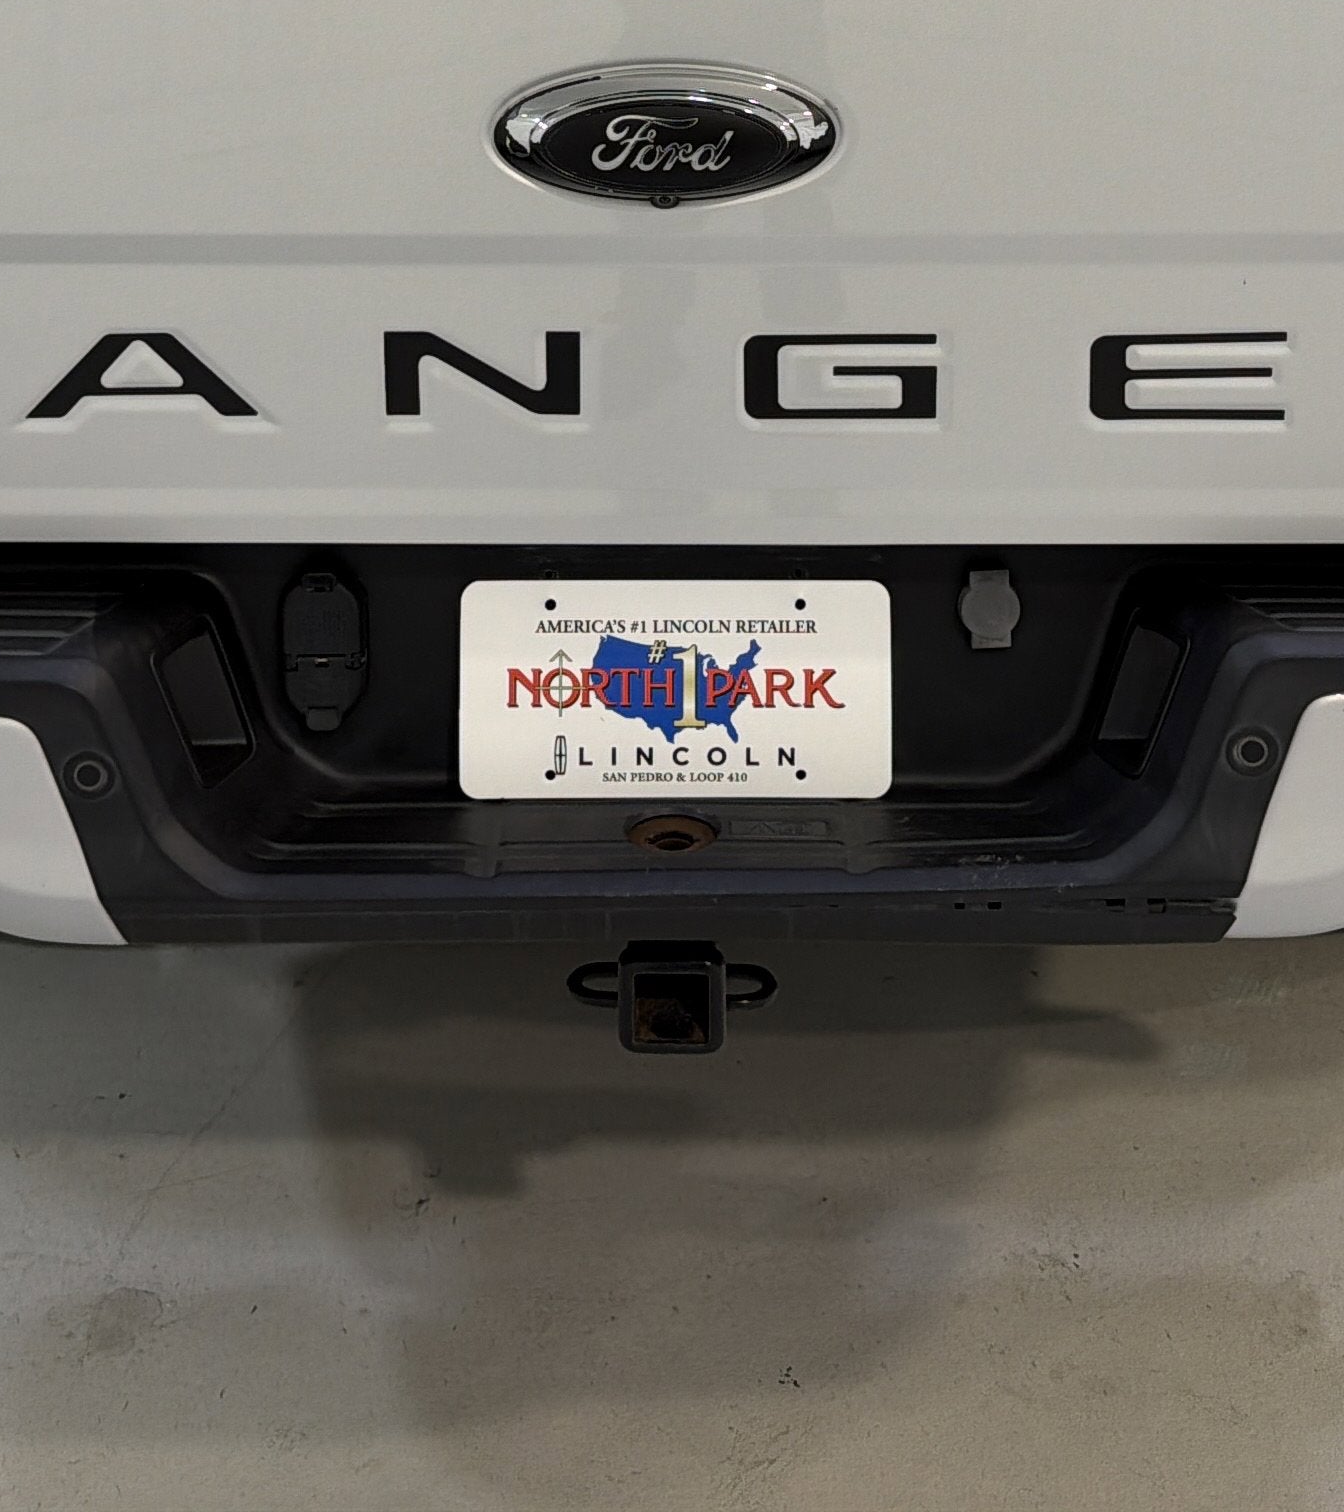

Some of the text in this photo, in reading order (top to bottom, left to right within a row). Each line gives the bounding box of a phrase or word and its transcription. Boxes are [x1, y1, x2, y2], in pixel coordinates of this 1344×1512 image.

[592, 114, 734, 171] Ford
[535, 619, 818, 634] AMERICA'S #1 LINCOLN RETAILER
[506, 667, 846, 708] NORTH PARK
[578, 746, 796, 767] LINCOLN
[602, 772, 749, 783] SAN PEDRO & LOOP 410
